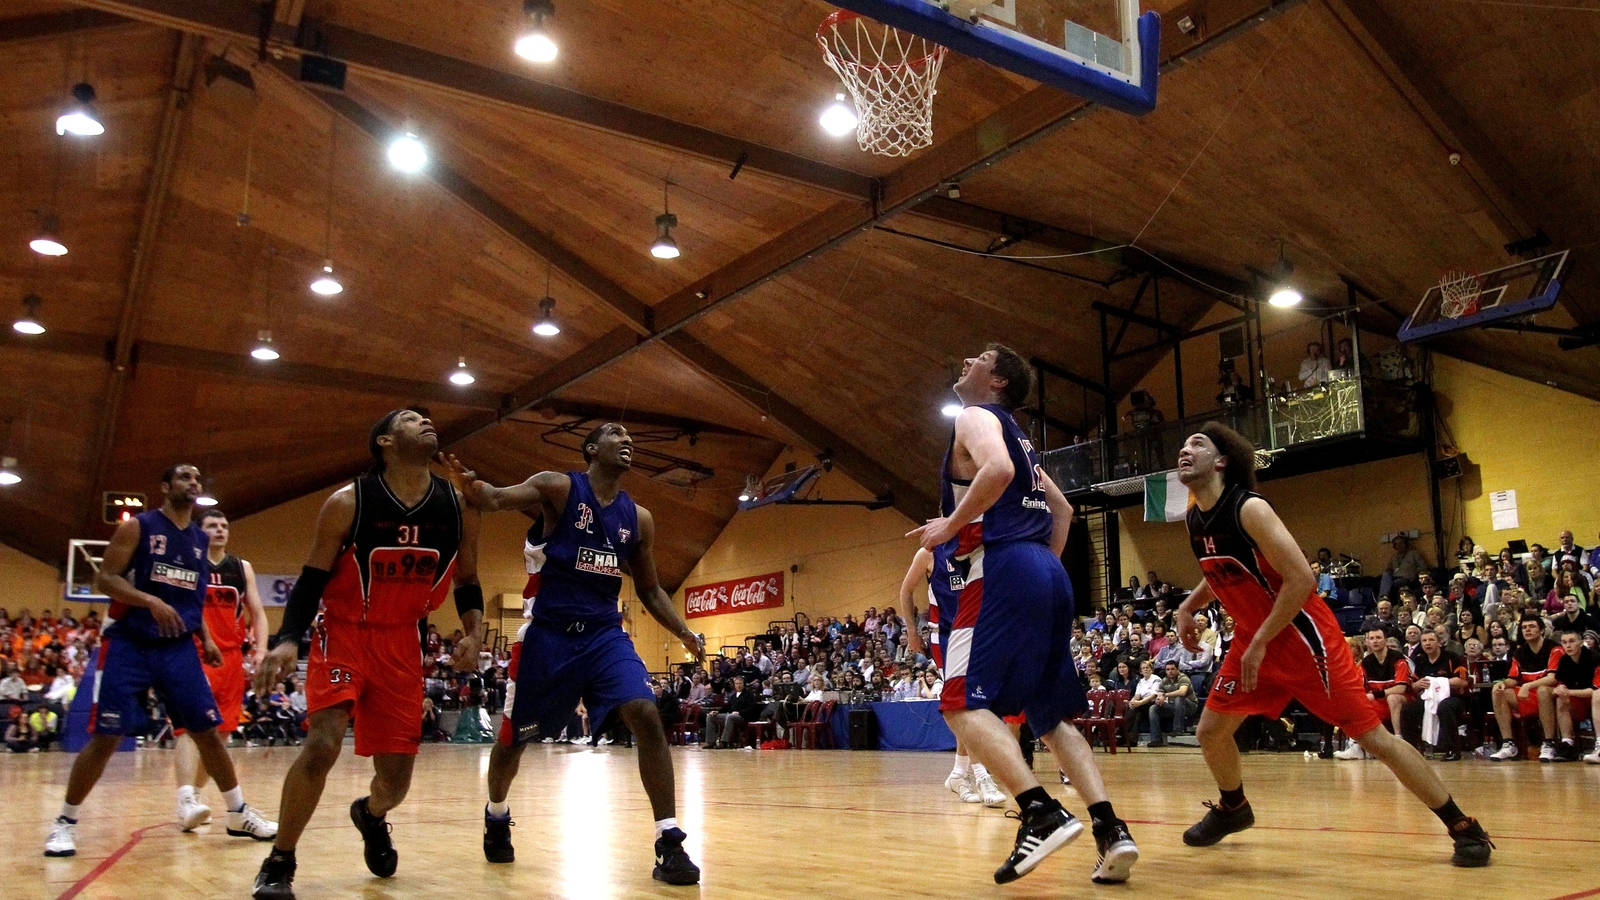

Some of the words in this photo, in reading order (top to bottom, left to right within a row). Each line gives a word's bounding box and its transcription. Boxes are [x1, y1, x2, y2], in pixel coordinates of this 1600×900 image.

[398, 525, 419, 544] 31
[1203, 536, 1217, 553] 14
[210, 572, 222, 585] 11
[1214, 676, 1236, 695] 14
